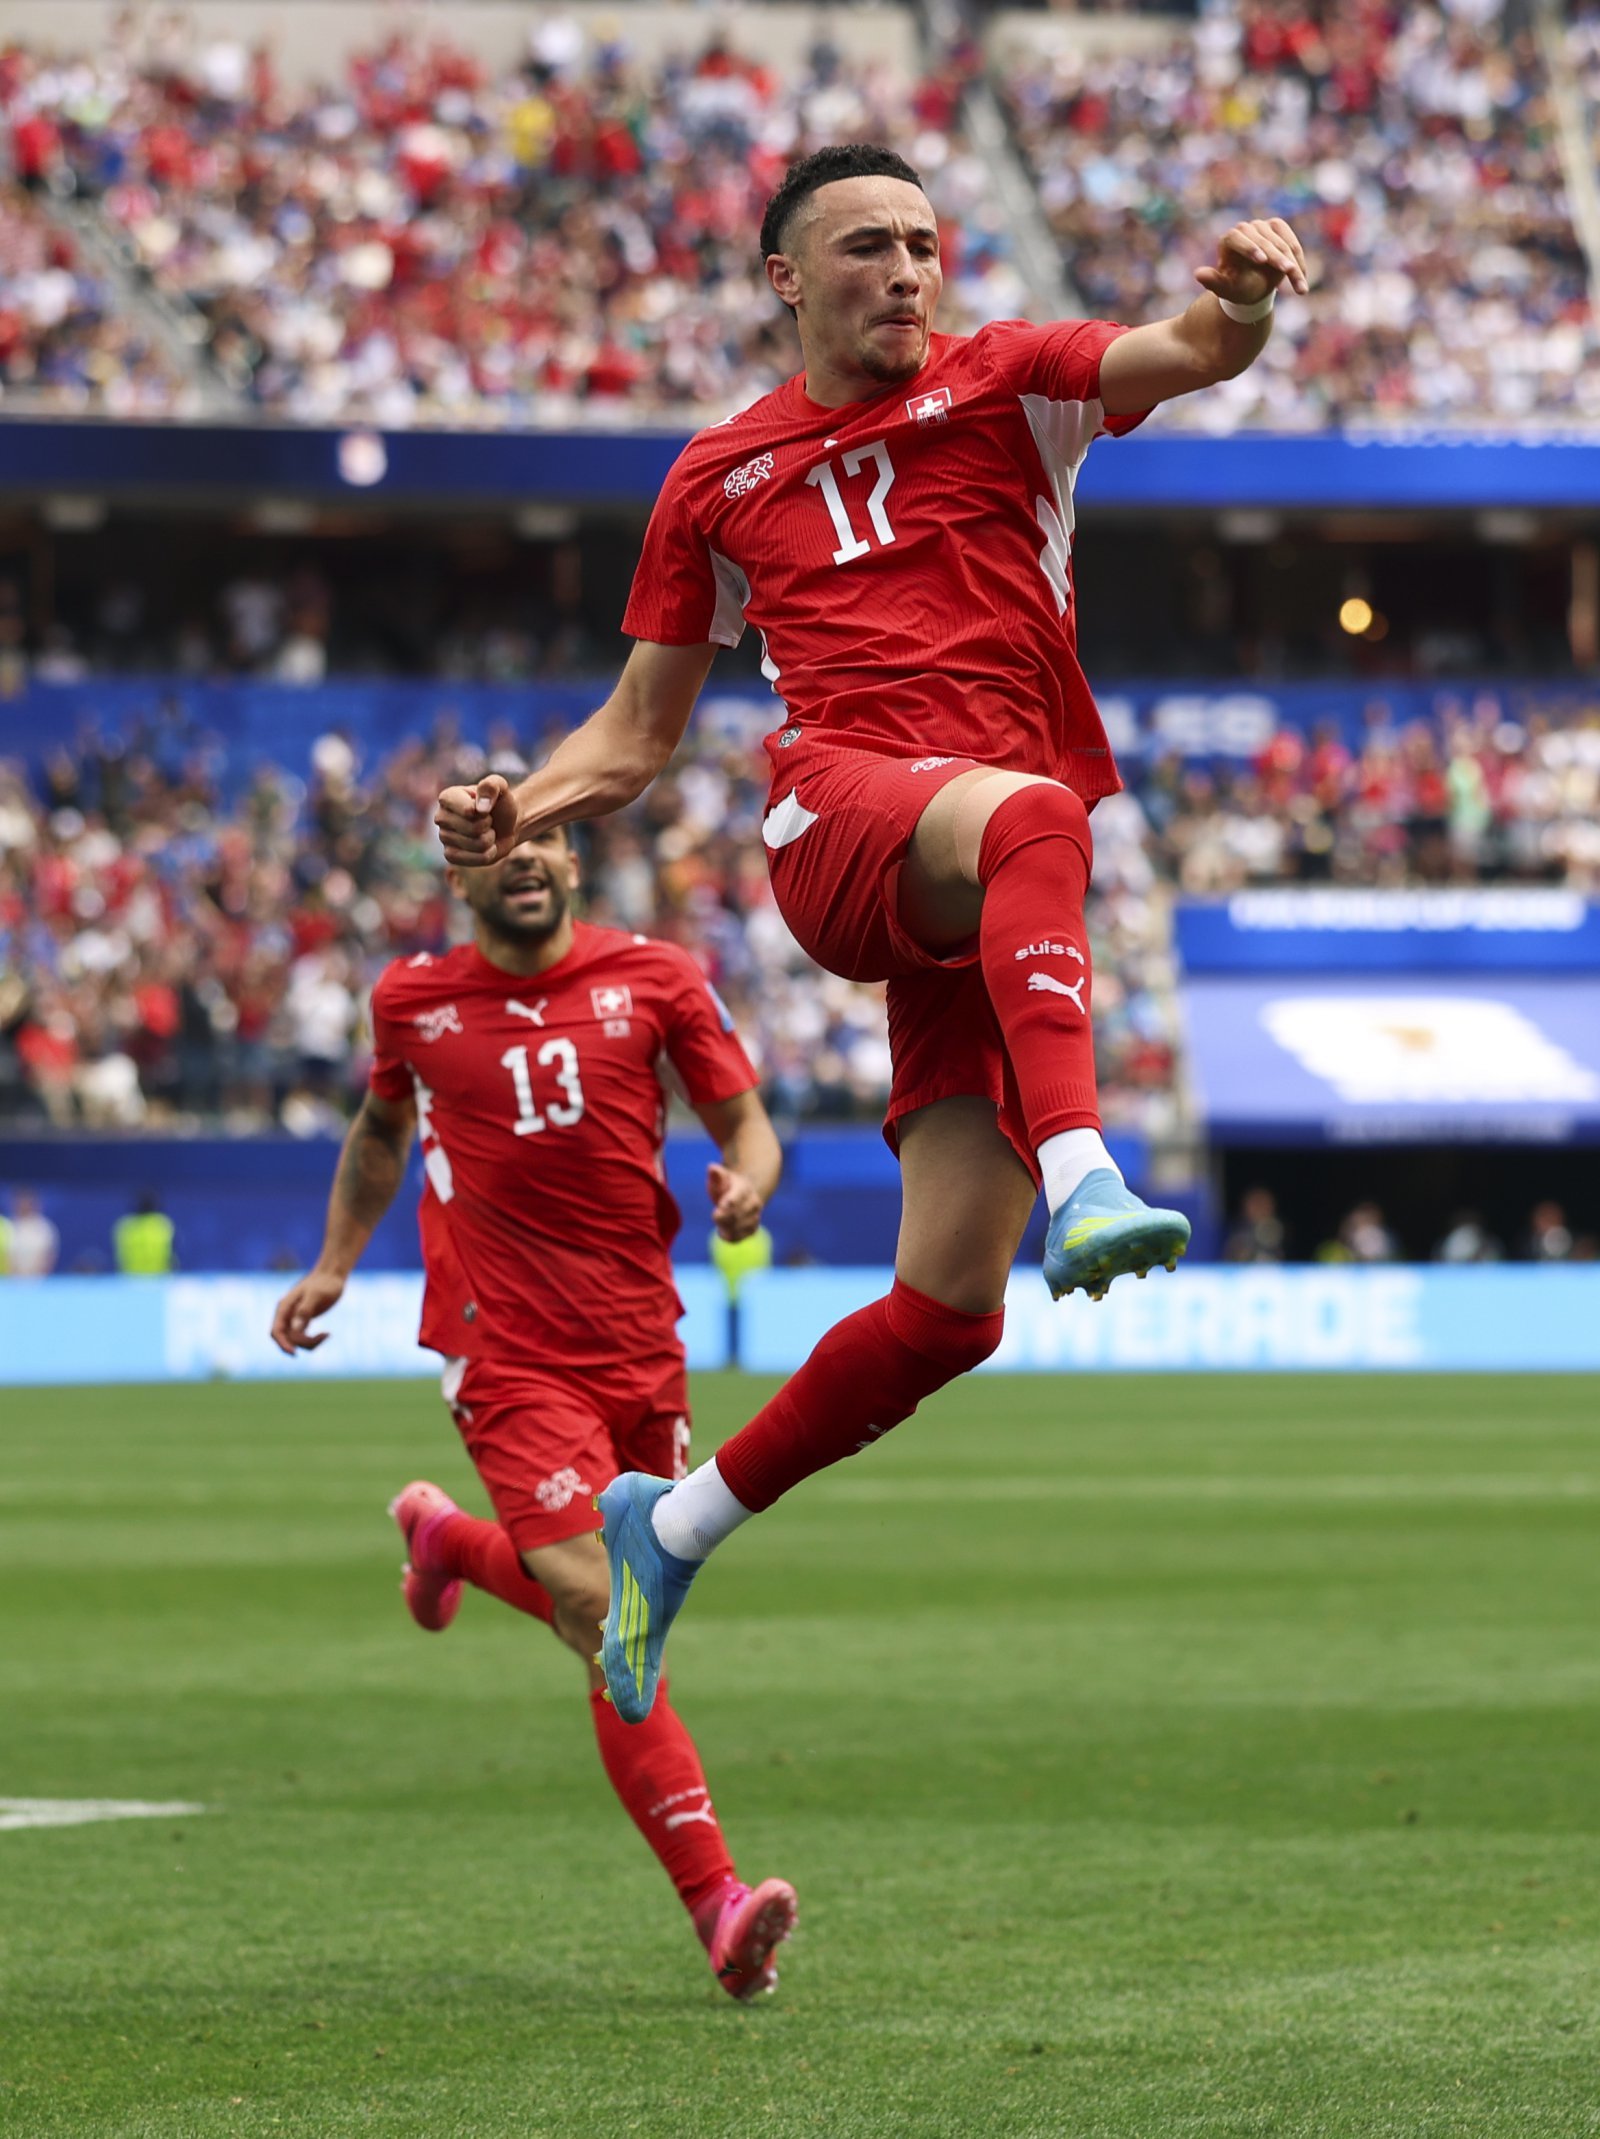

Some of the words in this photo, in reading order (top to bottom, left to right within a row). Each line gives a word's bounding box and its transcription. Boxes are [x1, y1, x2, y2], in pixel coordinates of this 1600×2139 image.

[804, 438, 896, 566] 17
[501, 1037, 584, 1136] 13
[984, 1268, 1424, 1367] WERADE
